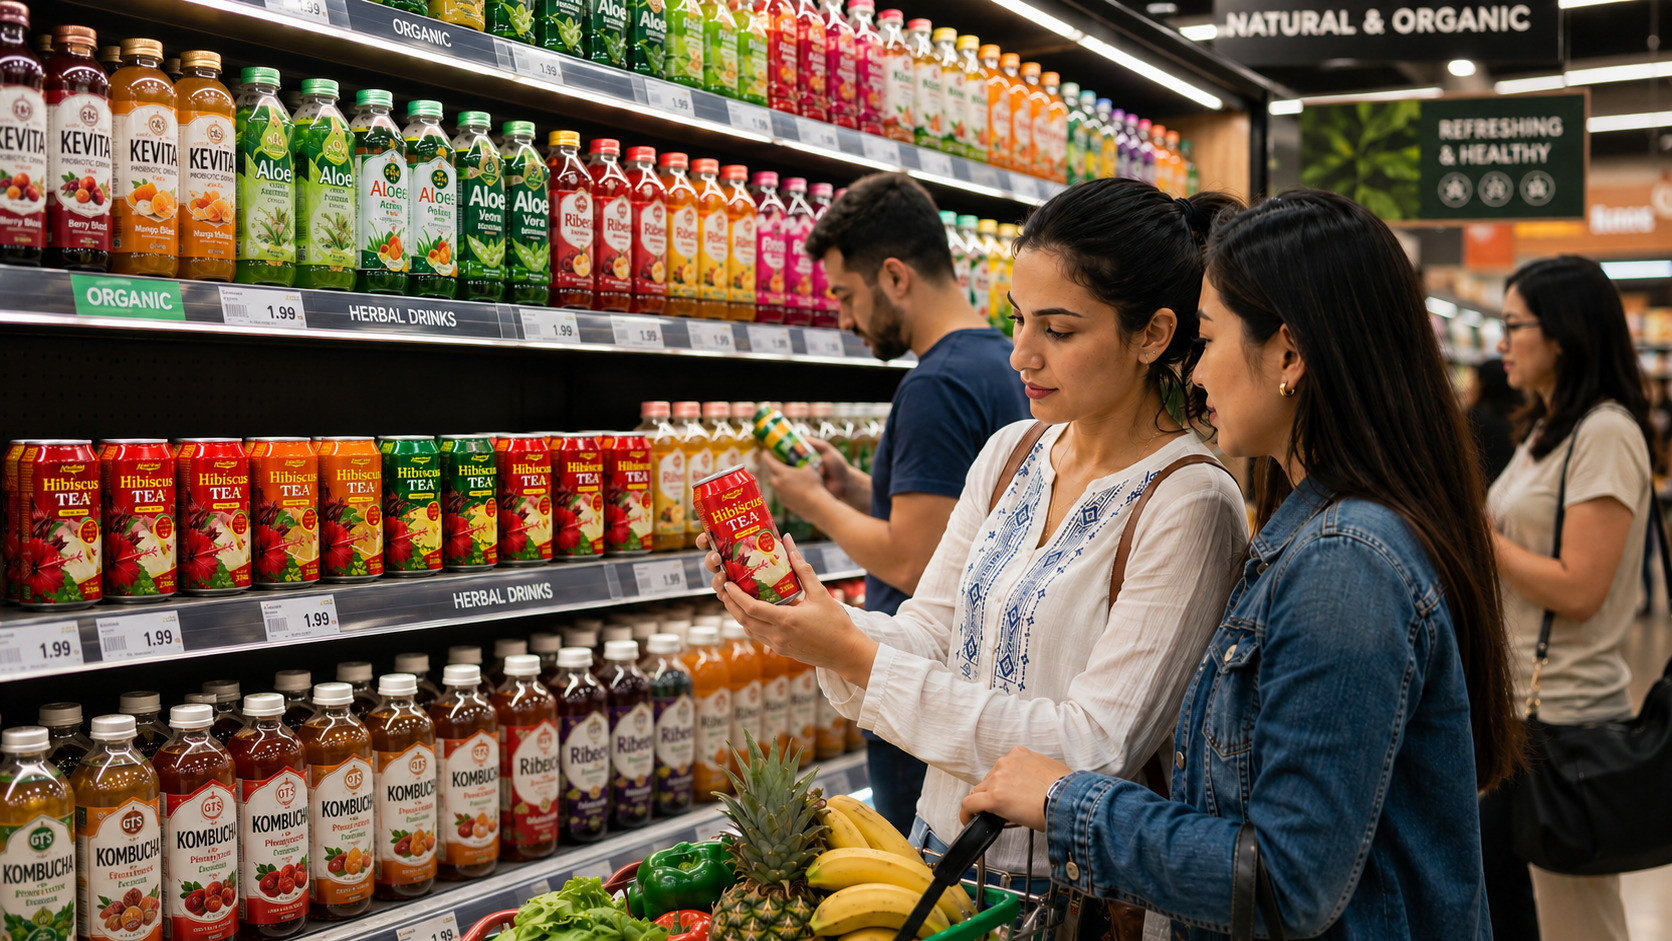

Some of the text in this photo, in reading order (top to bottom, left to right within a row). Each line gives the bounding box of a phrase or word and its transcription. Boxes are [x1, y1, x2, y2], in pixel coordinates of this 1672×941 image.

[639, 11, 667, 33] Aloe
[1226, 4, 1532, 38] NATURAL & ORGANIC
[393, 18, 452, 48] ORGANIC
[1438, 115, 1564, 140] REFRESHING
[61, 130, 111, 159] KEVITA
[130, 139, 178, 167] KEVITA
[190, 147, 235, 173] KEVITA
[1438, 142, 1552, 166] & HEALTHY
[255, 160, 292, 182] Aloe
[319, 166, 352, 187] Aloe
[469, 185, 506, 211] Aloe
[513, 190, 549, 215] Aloe
[86, 286, 173, 310] ORGANIC
[267, 305, 296, 320] 1.99
[349, 305, 457, 328] HERBAL DRINKS
[552, 324, 573, 337] 1.99
[43, 477, 99, 492] Hibiscus
[120, 475, 173, 488] Hibiscus
[199, 472, 249, 486] Hibiscus
[269, 470, 317, 484] Hibiscus
[406, 479, 435, 491] TEA
[467, 476, 493, 489] TEA
[521, 475, 547, 487] TEA
[576, 473, 600, 485] TEA
[625, 471, 648, 483] TEA
[131, 488, 166, 503] TEA
[209, 486, 242, 500] TEA
[280, 484, 310, 497] TEA
[346, 481, 375, 494] TEA
[55, 491, 91, 506] TEA
[711, 496, 763, 525] Hibiscus
[726, 511, 760, 532] TEA
[453, 582, 553, 609] HERBAL DRINKS
[304, 611, 329, 628] 1.99
[143, 629, 173, 647] 1.99
[39, 640, 71, 659] 1.99
[204, 801, 222, 812] GTS
[322, 793, 373, 817] KOMBUCH
[123, 815, 143, 830] GTS
[252, 806, 308, 833] KOMBUCH
[30, 831, 53, 846] GTS
[3, 853, 74, 885] KOMBUCHA
